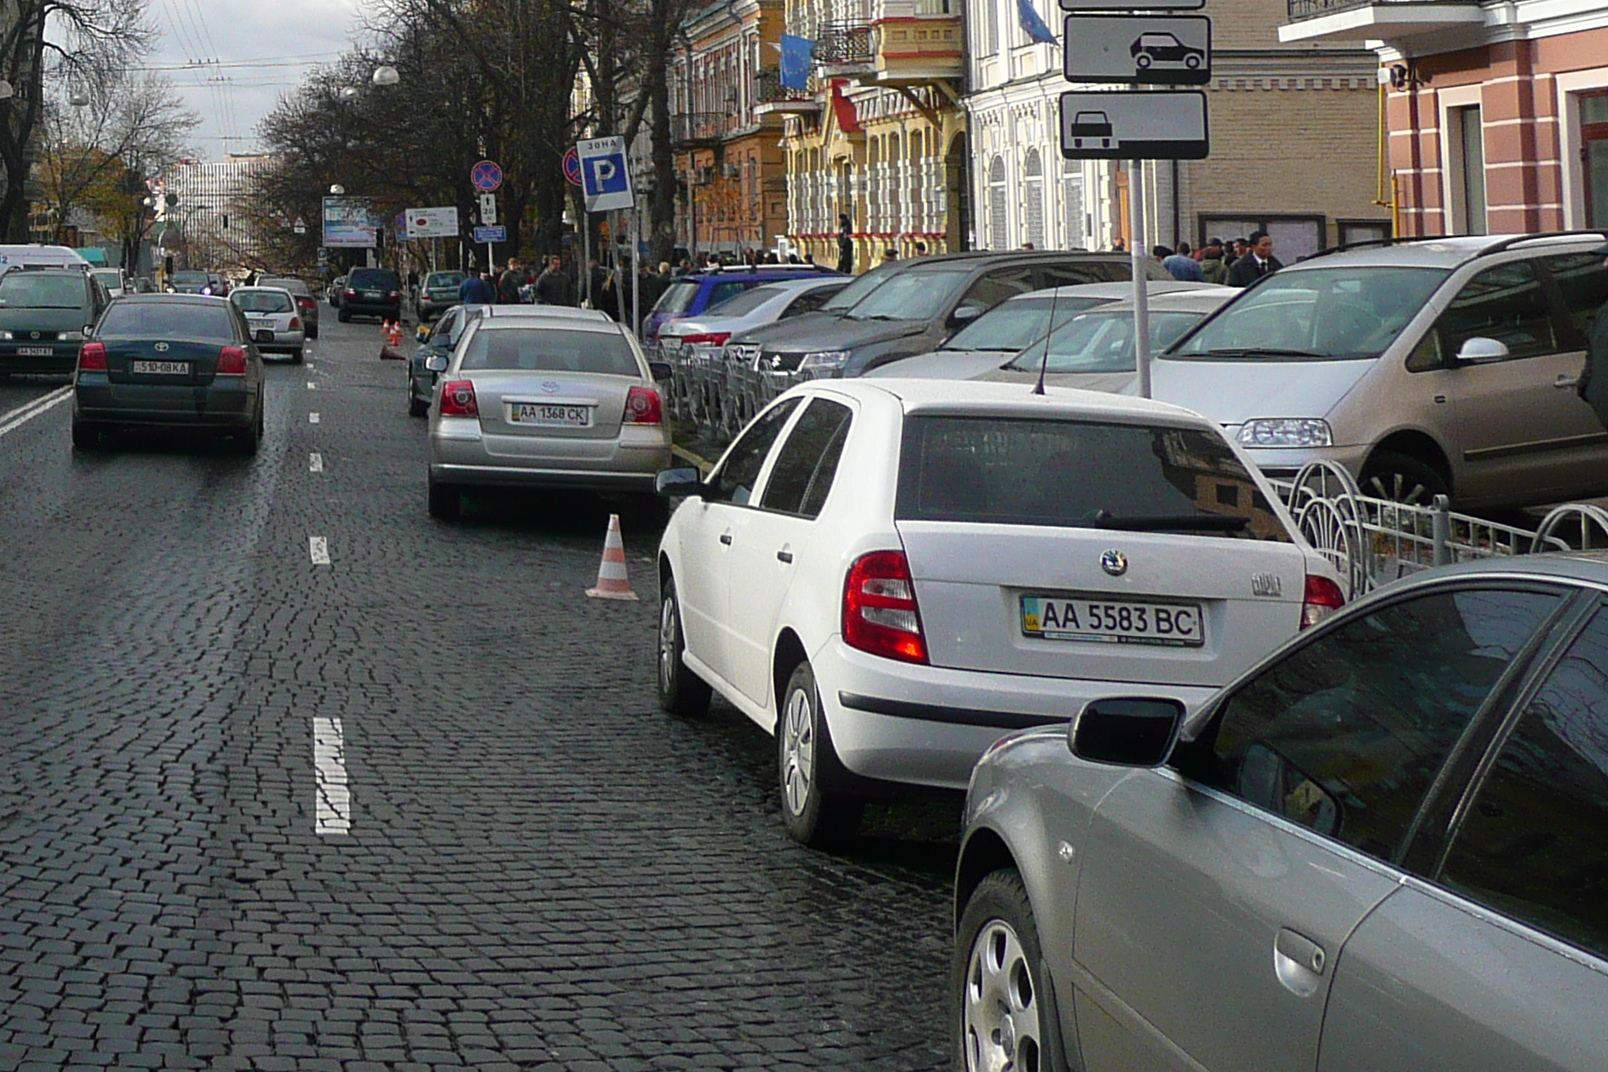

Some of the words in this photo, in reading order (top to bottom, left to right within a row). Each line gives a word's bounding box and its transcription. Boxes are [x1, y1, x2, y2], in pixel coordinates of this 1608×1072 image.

[593, 159, 616, 192] P
[520, 406, 536, 418] AA
[540, 407, 565, 419] 1368
[567, 409, 584, 420] CK
[1043, 601, 1080, 629] AA
[1088, 604, 1148, 633] 5583
[1155, 608, 1193, 635] BC
